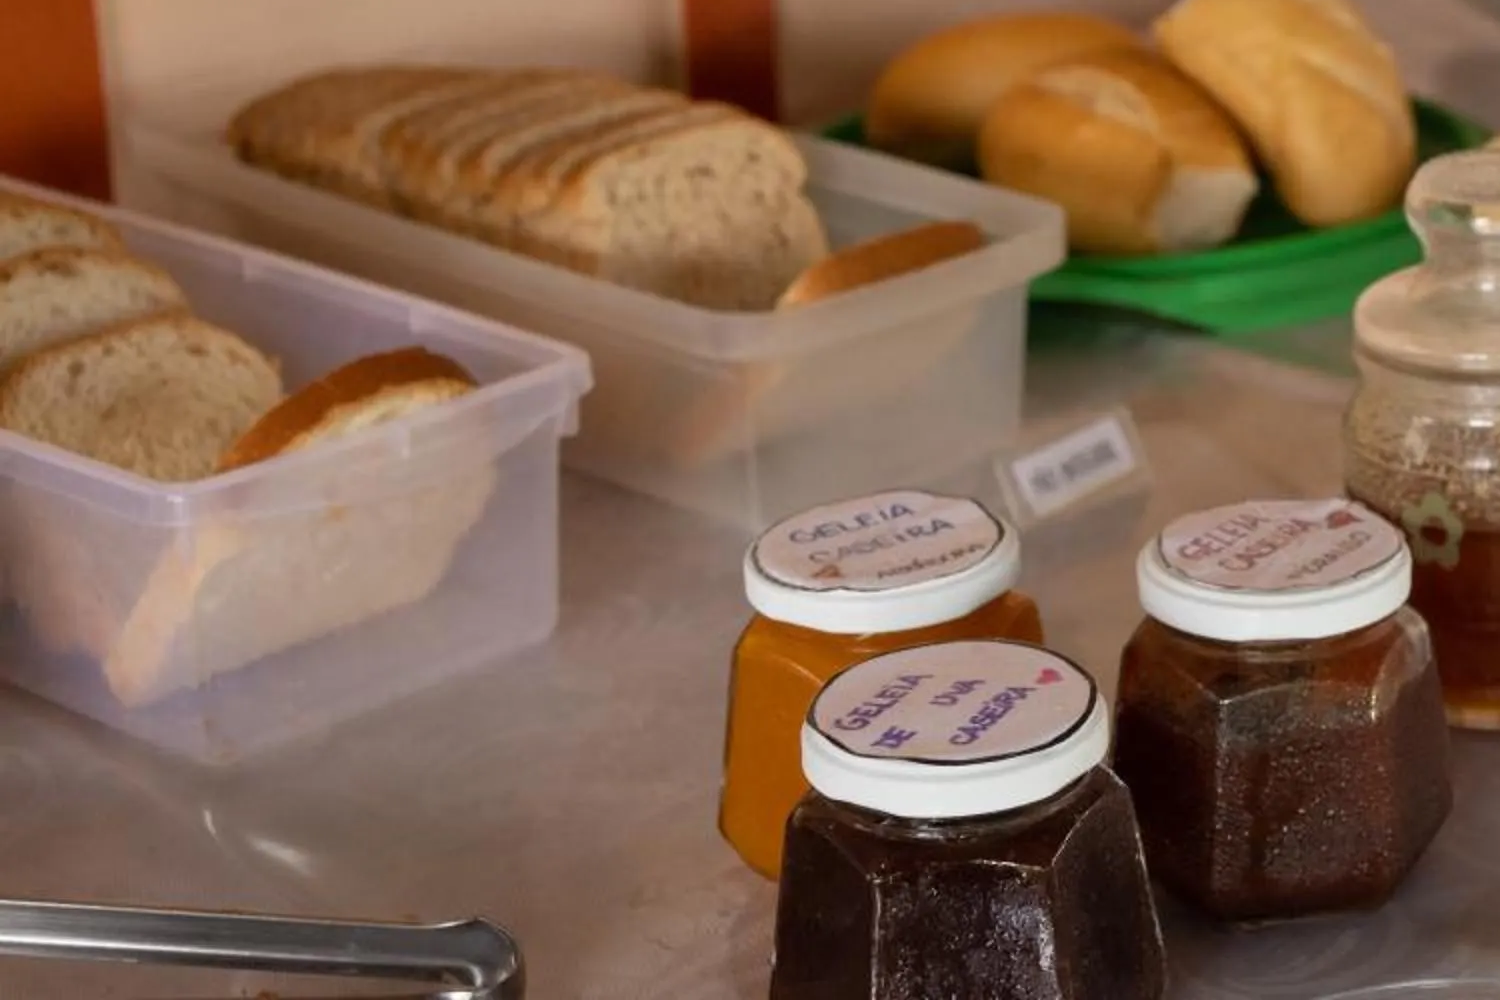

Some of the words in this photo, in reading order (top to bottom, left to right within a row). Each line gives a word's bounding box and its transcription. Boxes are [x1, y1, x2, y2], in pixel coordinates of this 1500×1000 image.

[834, 674, 934, 731] GELEIA
[871, 726, 917, 749] DE
[929, 678, 986, 706] UVA
[949, 686, 1037, 745] CASEIRA
